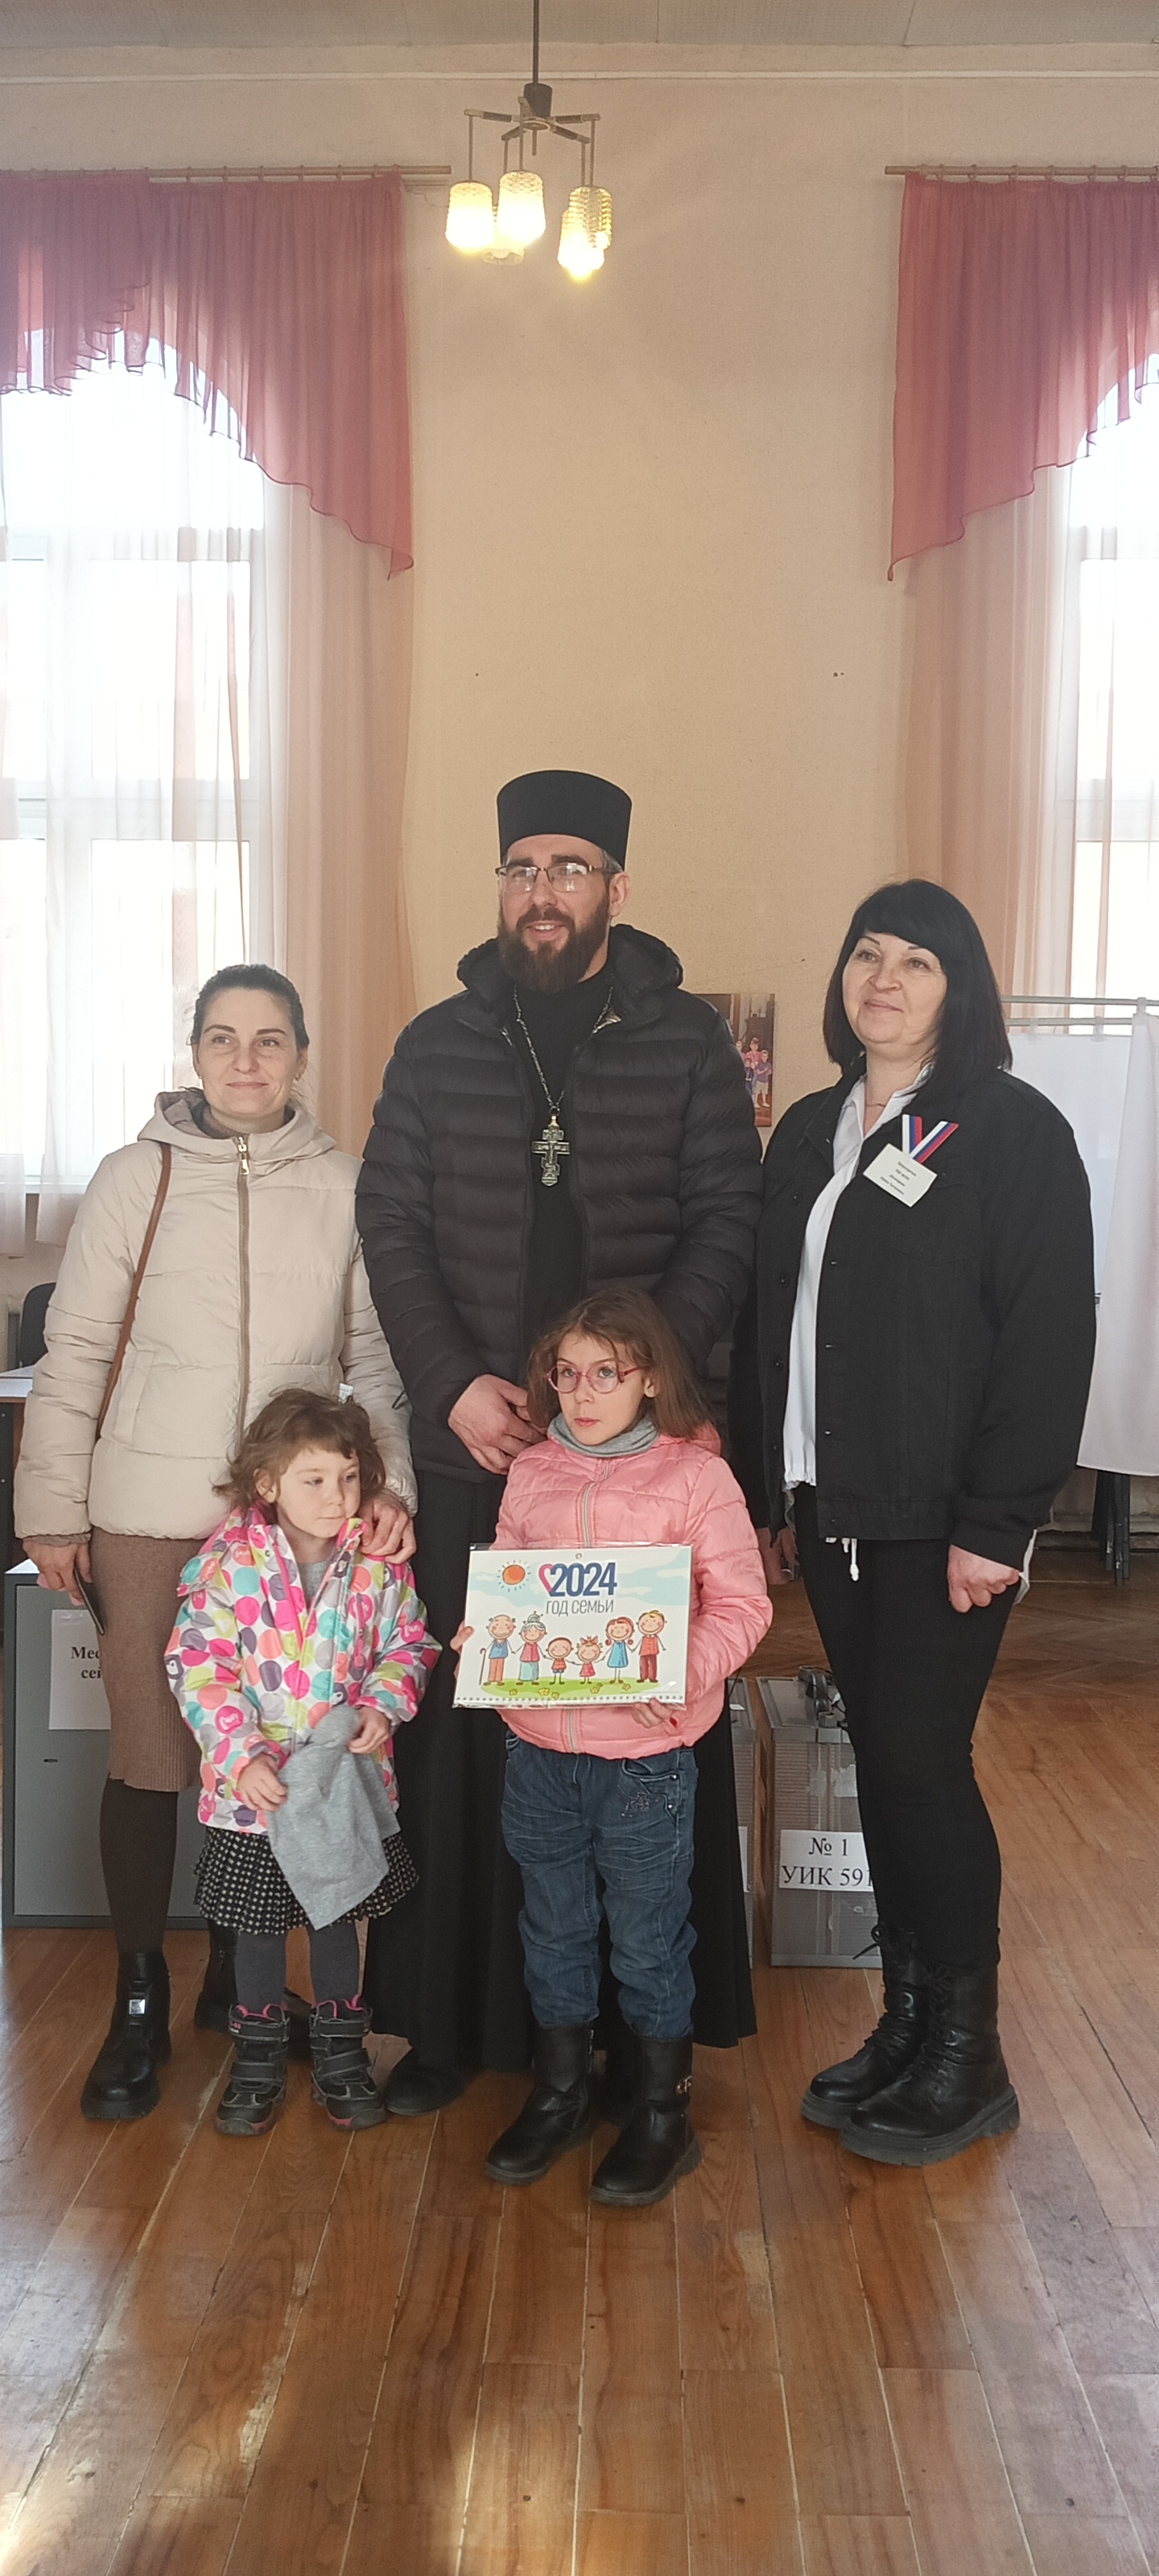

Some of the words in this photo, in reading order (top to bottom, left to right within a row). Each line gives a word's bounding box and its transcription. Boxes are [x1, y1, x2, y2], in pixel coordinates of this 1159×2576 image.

[549, 1562, 617, 1596] 2024
[808, 1837, 832, 1856] №
[841, 1839, 848, 1856] 1
[782, 1865, 833, 1885] УИК
